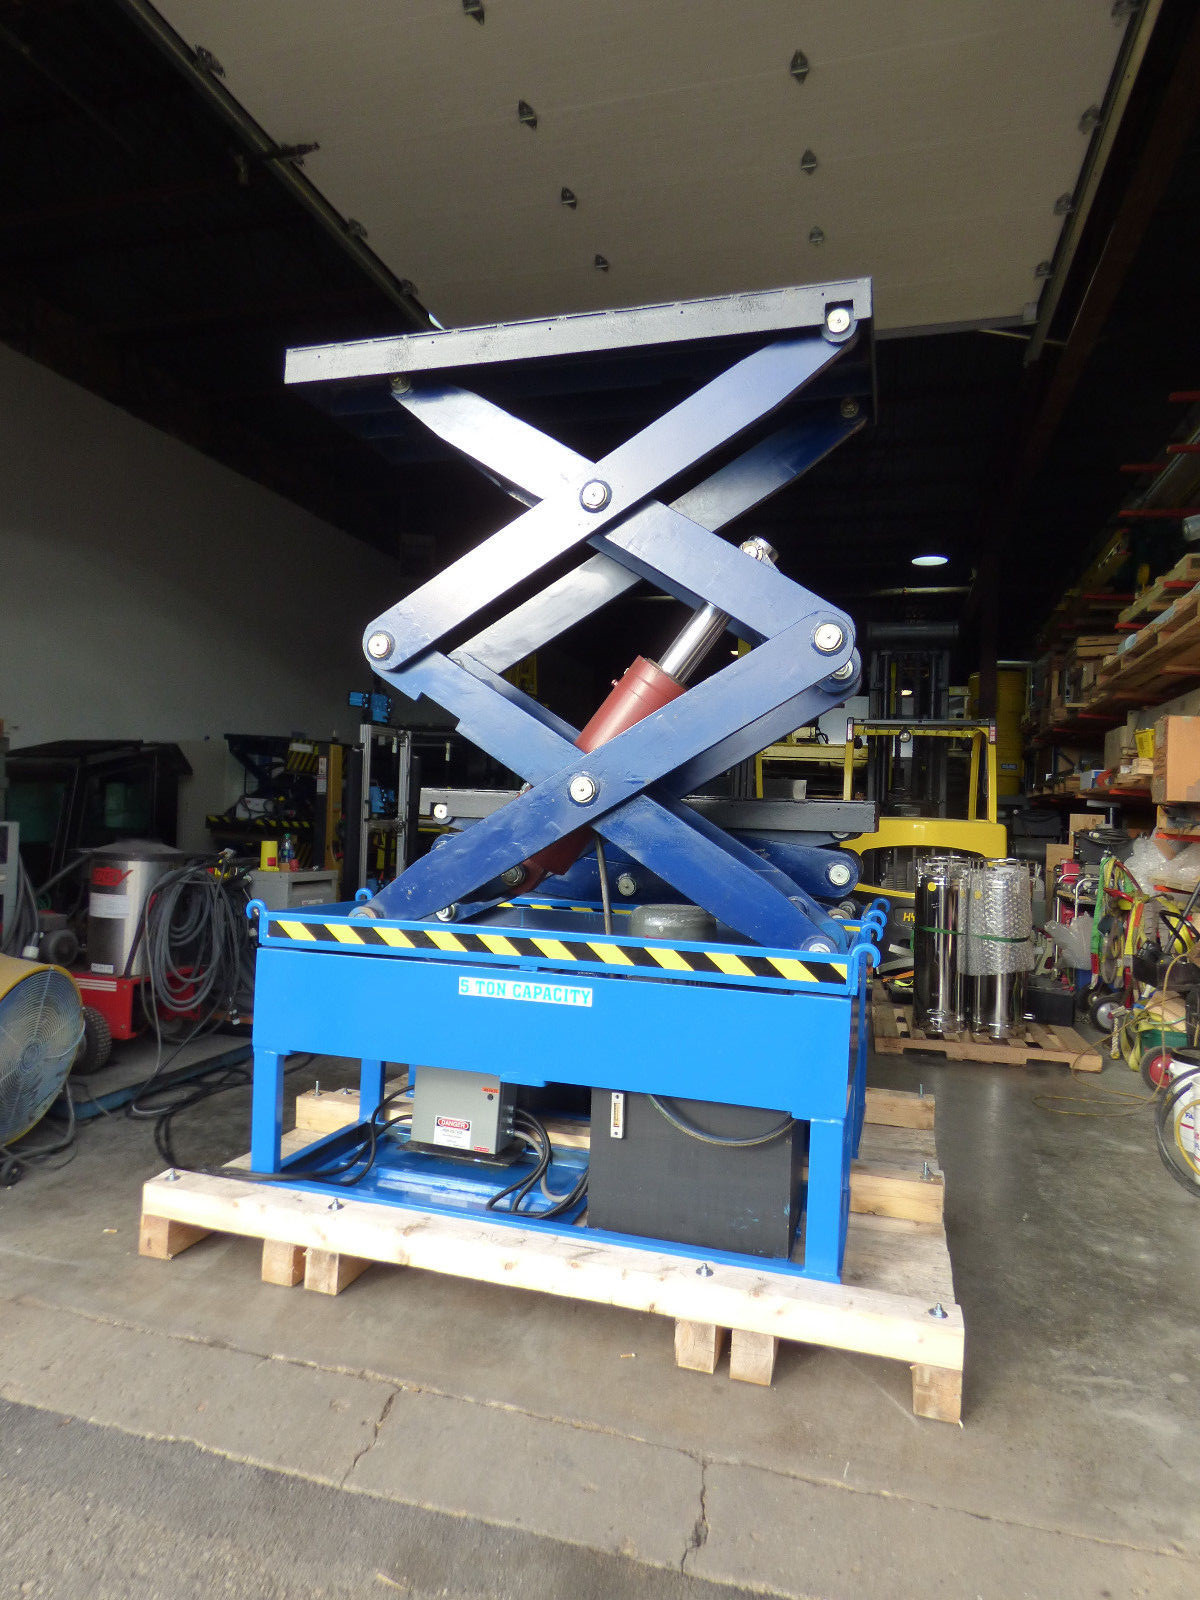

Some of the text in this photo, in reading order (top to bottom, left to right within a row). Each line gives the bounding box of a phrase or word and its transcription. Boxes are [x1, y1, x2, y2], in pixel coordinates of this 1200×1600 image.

[460, 979, 590, 1005] 5 TON CAPACITY
[441, 1119, 465, 1129] DANGER
